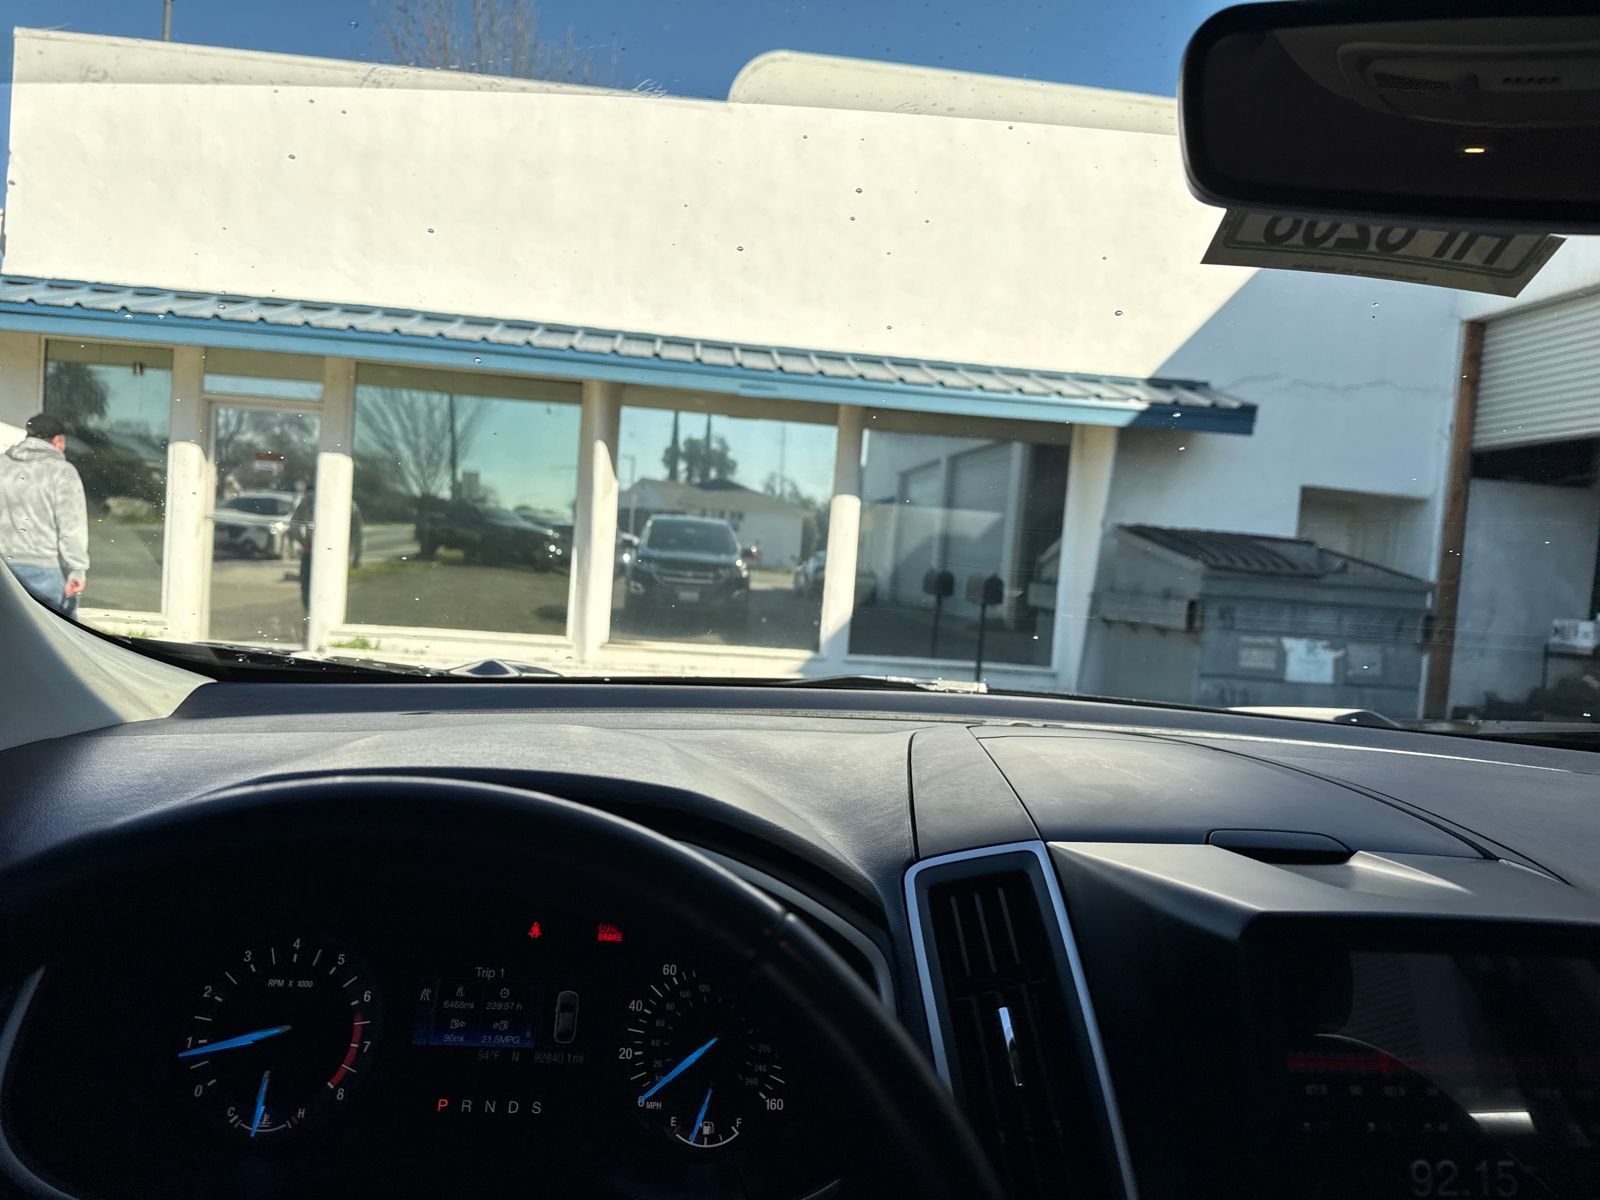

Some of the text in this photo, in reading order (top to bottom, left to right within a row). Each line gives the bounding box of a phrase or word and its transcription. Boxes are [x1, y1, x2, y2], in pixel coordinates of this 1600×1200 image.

[292, 937, 301, 949] 4
[243, 950, 252, 962] 3
[337, 953, 346, 965] 5
[474, 966, 496, 980] Trip
[662, 963, 677, 976] 60
[267, 978, 285, 988] RPM
[297, 979, 314, 988] 1000
[202, 985, 213, 998] 2
[363, 990, 372, 1003] 6
[628, 999, 643, 1012] 40
[186, 1036, 193, 1048] 1
[362, 1040, 371, 1053] 7
[618, 1047, 633, 1060] 20
[193, 1084, 203, 1098] 0
[336, 1088, 345, 1101] 8
[436, 1098, 543, 1114] P R N D S
[646, 1101, 662, 1110] MPH
[765, 1098, 784, 1111] 160
[227, 1106, 236, 1117] C
[297, 1108, 306, 1118] H
[670, 1116, 677, 1127] E
[736, 1117, 743, 1128] F
